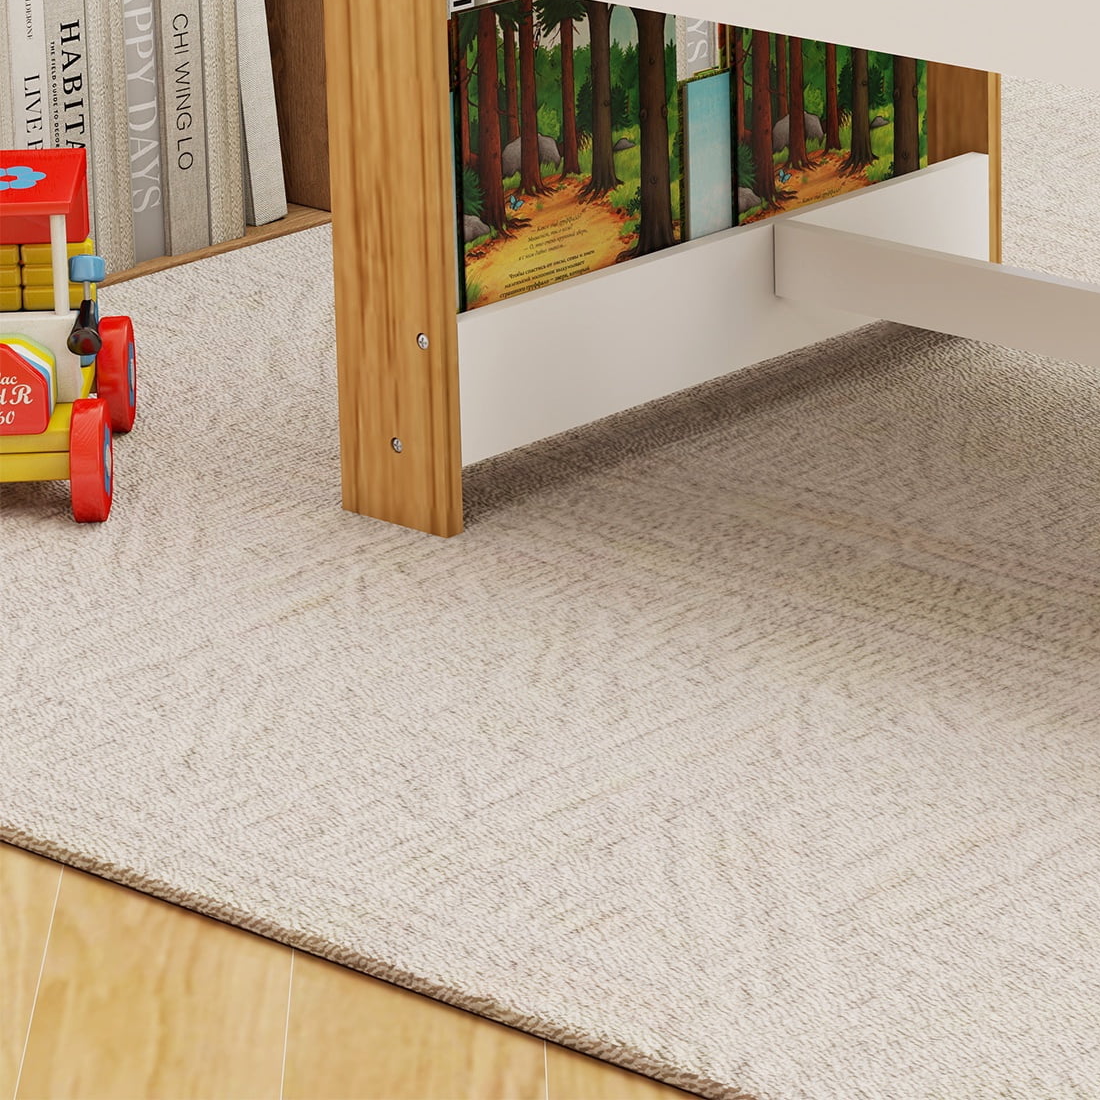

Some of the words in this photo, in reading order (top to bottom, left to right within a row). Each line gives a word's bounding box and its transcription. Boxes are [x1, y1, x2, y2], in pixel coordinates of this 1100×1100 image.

[172, 12, 190, 55] CHI
[24, 74, 42, 133] LIVE
[53, 109, 59, 120] TO
[174, 61, 194, 132] WING
[128, 96, 162, 214] DAYS
[176, 136, 194, 171] LO
